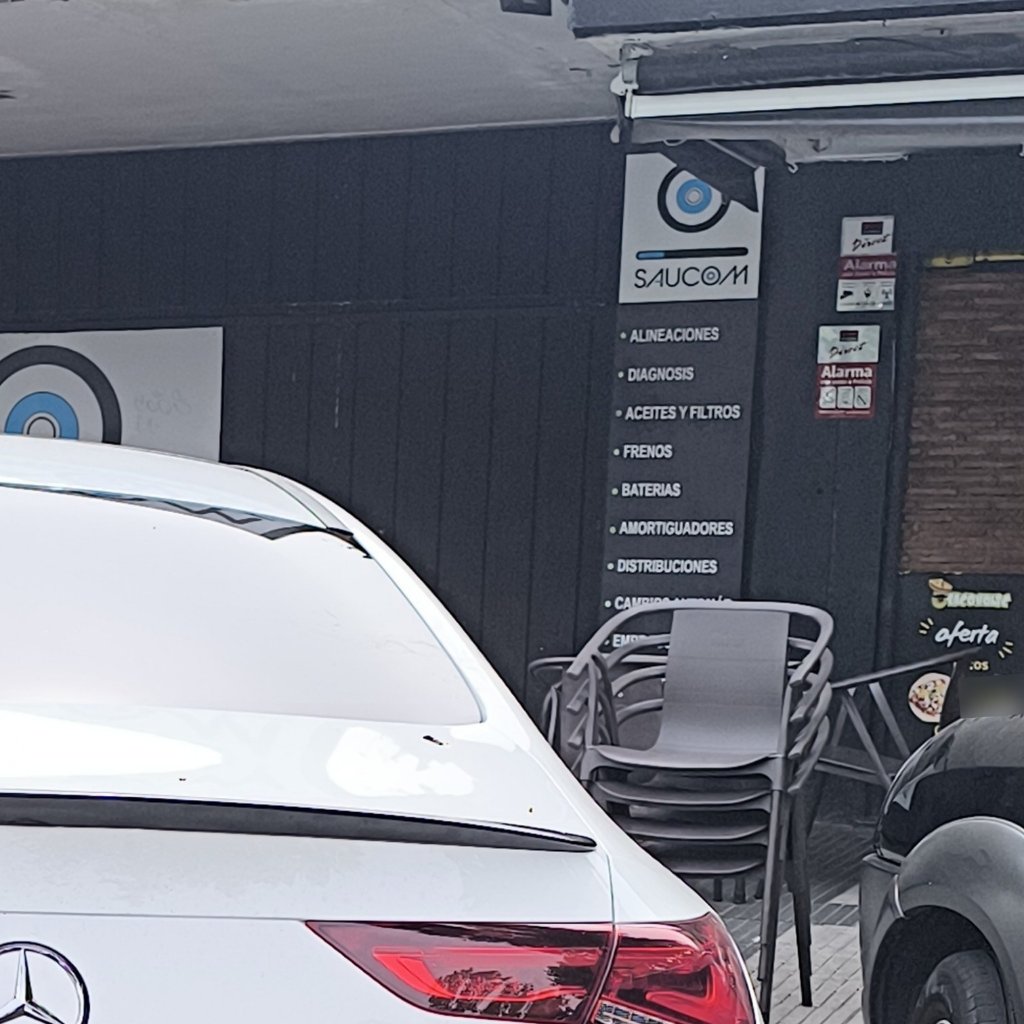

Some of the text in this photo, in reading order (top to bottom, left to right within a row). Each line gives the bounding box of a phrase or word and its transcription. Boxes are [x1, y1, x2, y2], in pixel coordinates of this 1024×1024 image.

[634, 265, 748, 288] SAUCOM
[630, 327, 719, 343] ALINEACIONES
[627, 367, 694, 382] DIAGNOSIS
[821, 365, 873, 379] Alarma
[625, 405, 741, 420] ACEITES Y FILTROS
[623, 445, 673, 459] FRENOS
[621, 483, 681, 497] BATERIAS
[619, 522, 734, 536] AMORTIGUADORES
[617, 559, 718, 573] DISTRIBUCIONES
[934, 620, 999, 647] oferta
